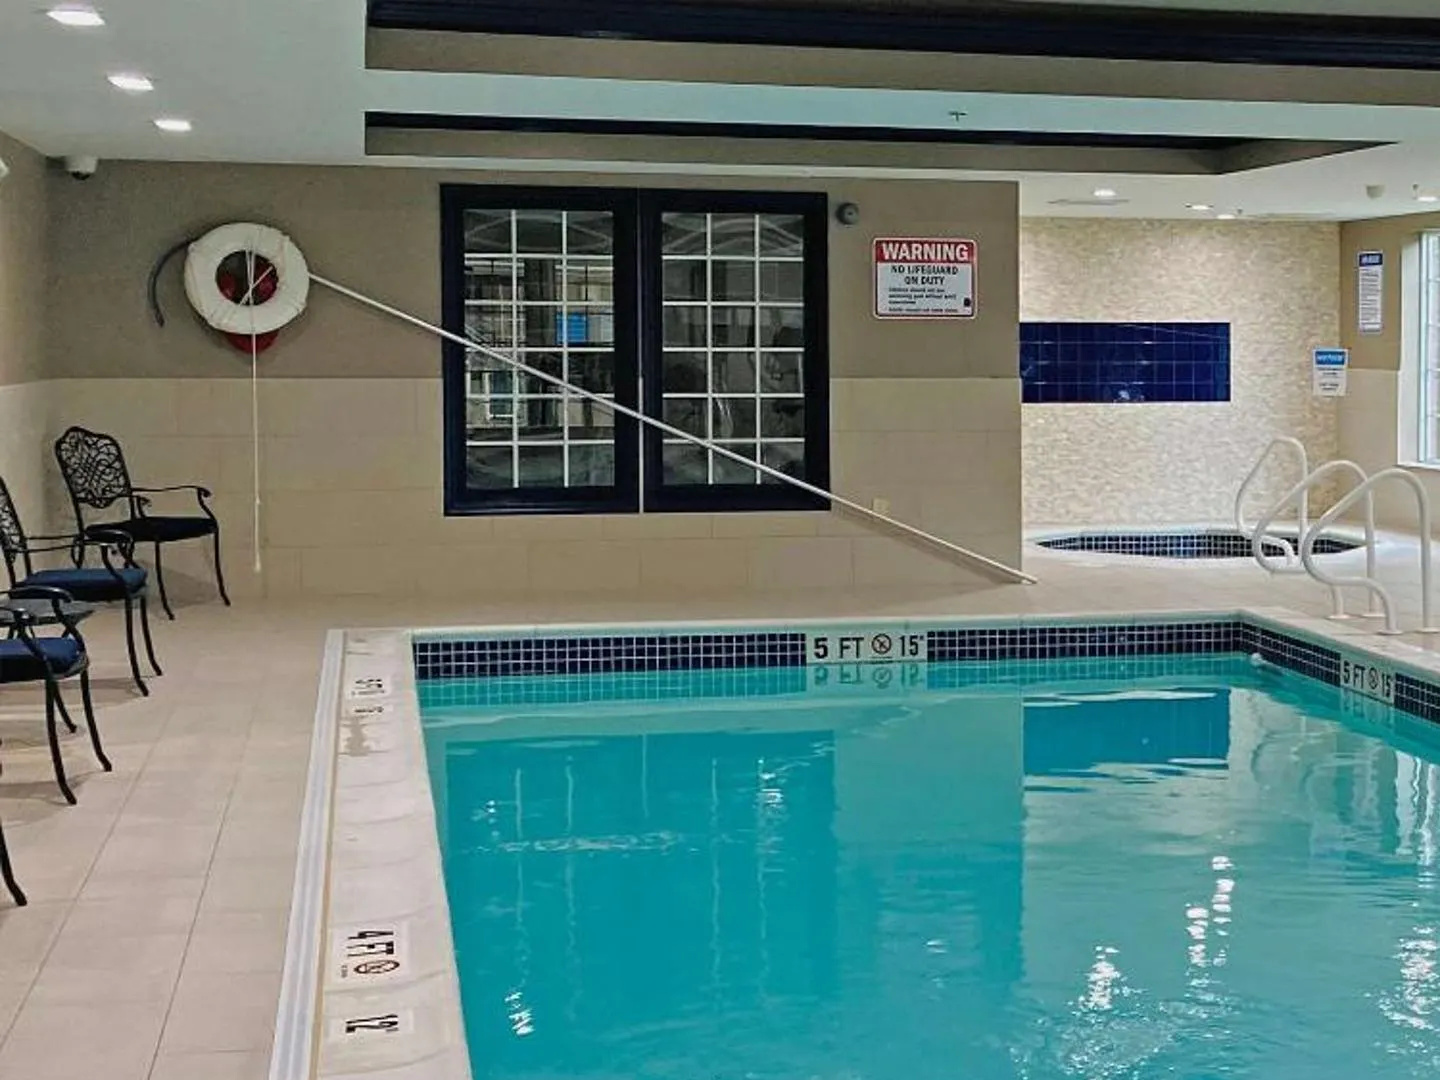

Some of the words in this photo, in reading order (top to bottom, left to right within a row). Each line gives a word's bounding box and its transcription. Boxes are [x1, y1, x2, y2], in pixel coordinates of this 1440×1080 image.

[882, 242, 968, 261] WARNING
[891, 265, 905, 274] NO
[907, 265, 959, 276] LIFEGUARD
[904, 276, 918, 286] ON
[920, 276, 945, 286] DUTY
[814, 637, 828, 659] 5
[839, 636, 865, 659] FT
[1343, 660, 1351, 684] 5
[1353, 664, 1365, 689] FT
